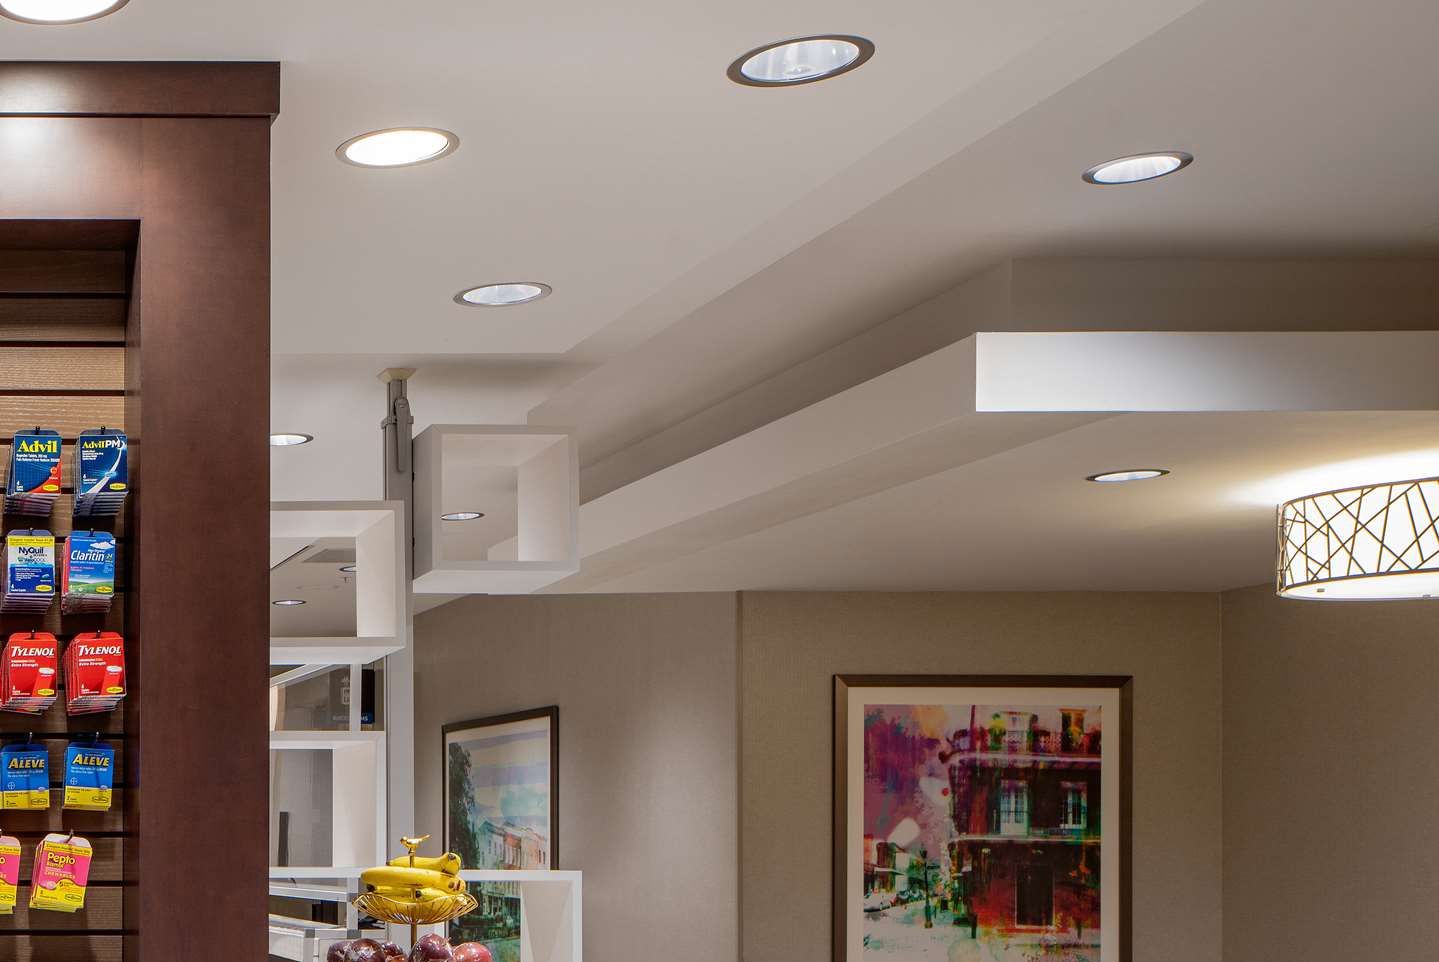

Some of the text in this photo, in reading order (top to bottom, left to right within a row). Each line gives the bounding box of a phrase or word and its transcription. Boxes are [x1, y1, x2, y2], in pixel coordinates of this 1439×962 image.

[17, 440, 57, 453] Advil
[105, 440, 120, 448] PM
[19, 547, 44, 555] NyQuil
[71, 550, 104, 561] Claritin
[11, 646, 54, 657] TYLENOL
[78, 645, 121, 656] TYLENOL
[47, 852, 75, 864] Pepto
